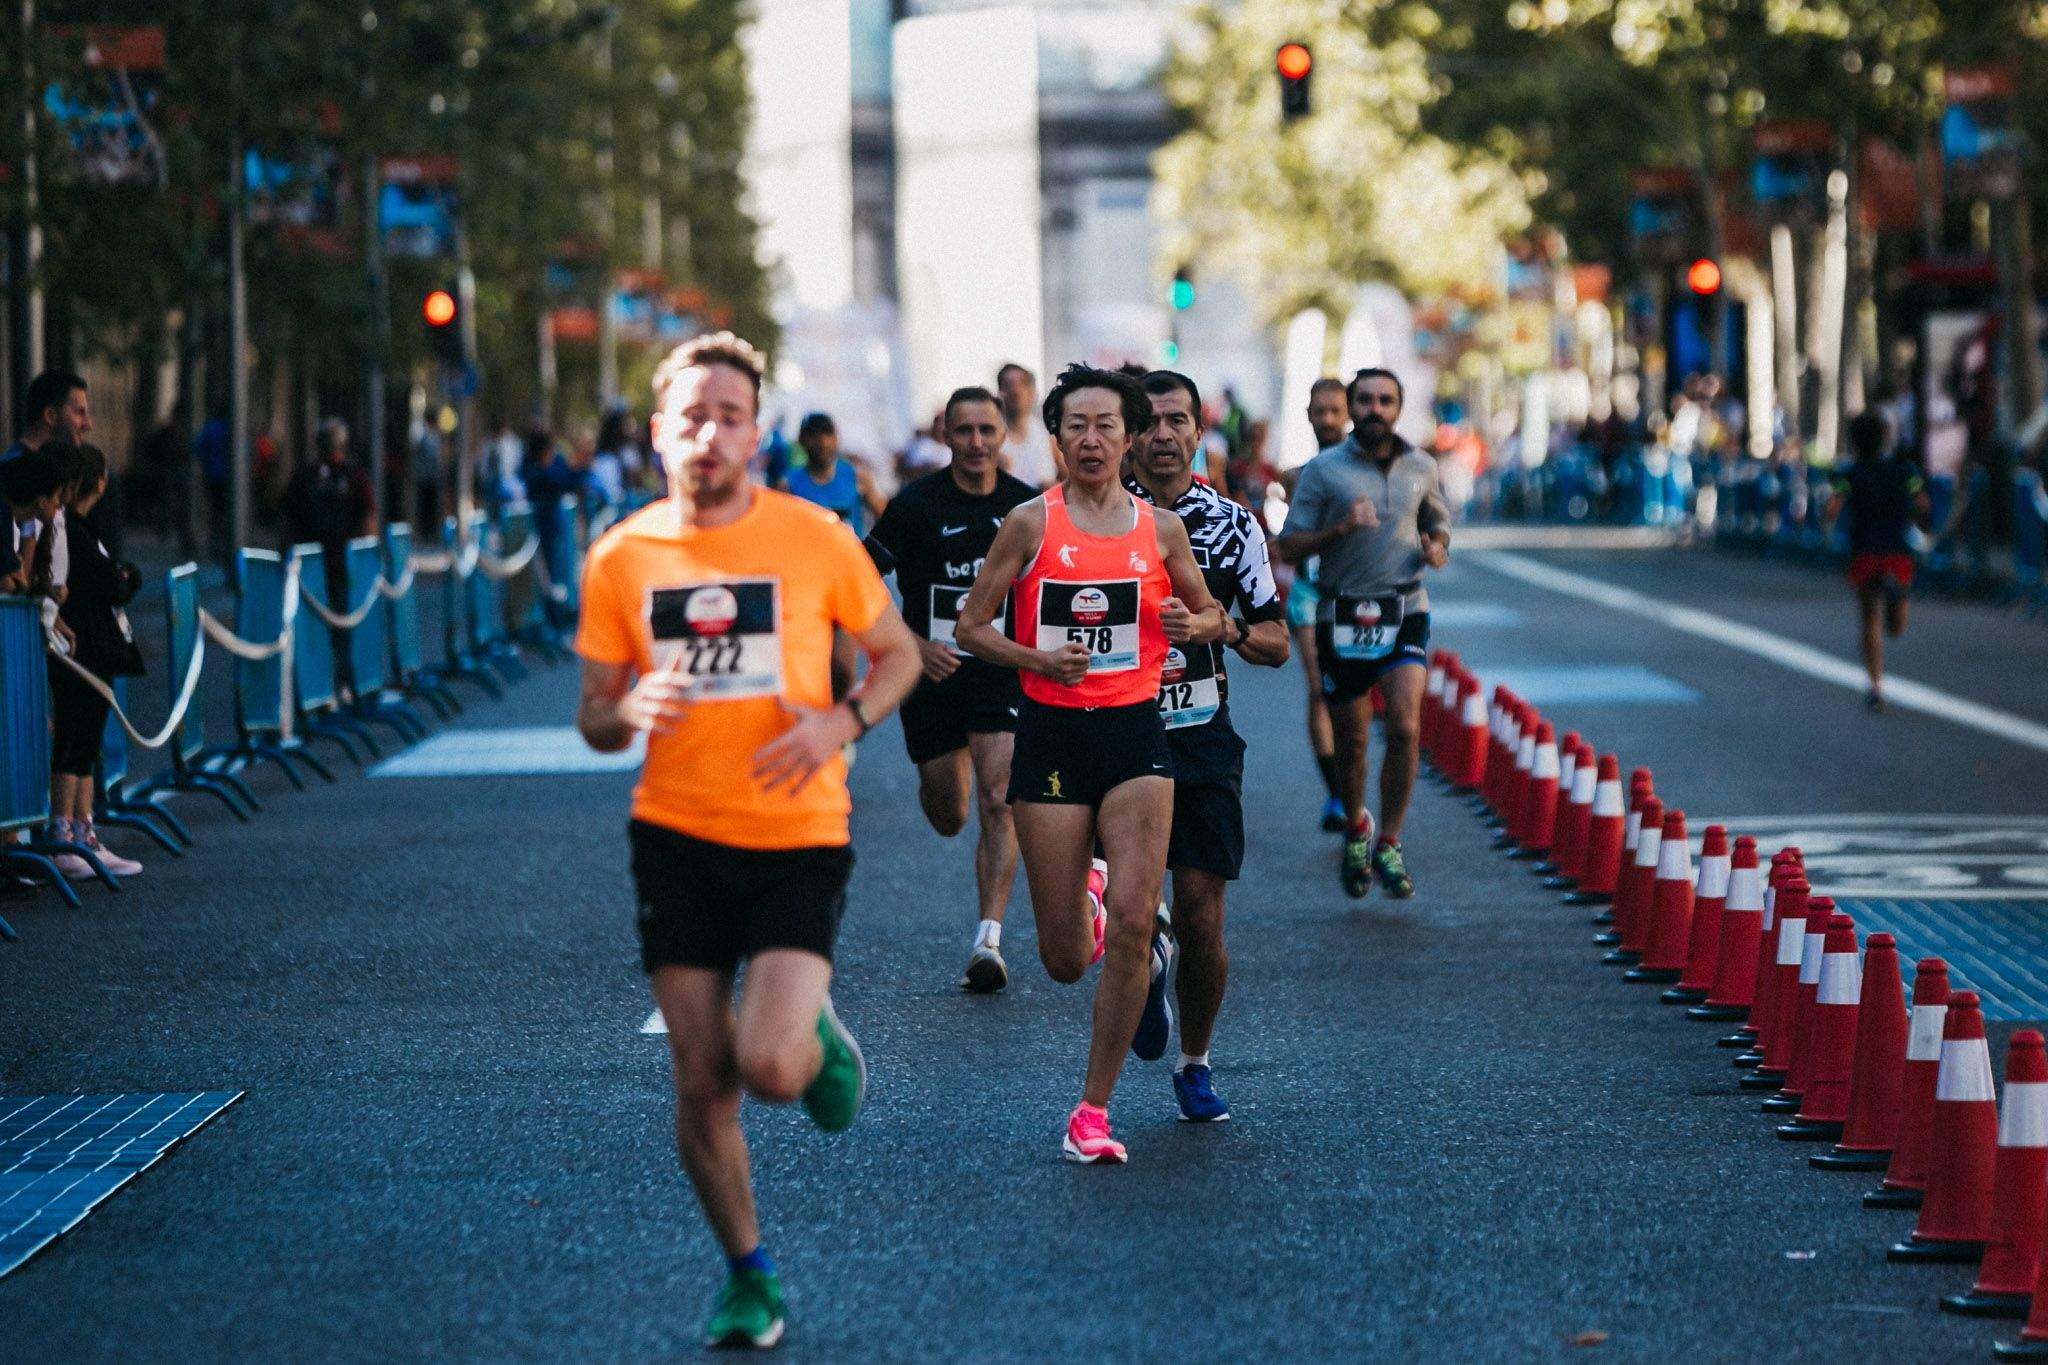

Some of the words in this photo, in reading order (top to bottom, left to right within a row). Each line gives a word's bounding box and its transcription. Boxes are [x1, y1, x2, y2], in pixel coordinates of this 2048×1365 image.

[1067, 627, 1113, 654] 578
[686, 636, 742, 676] 222
[1157, 683, 1194, 712] 212
